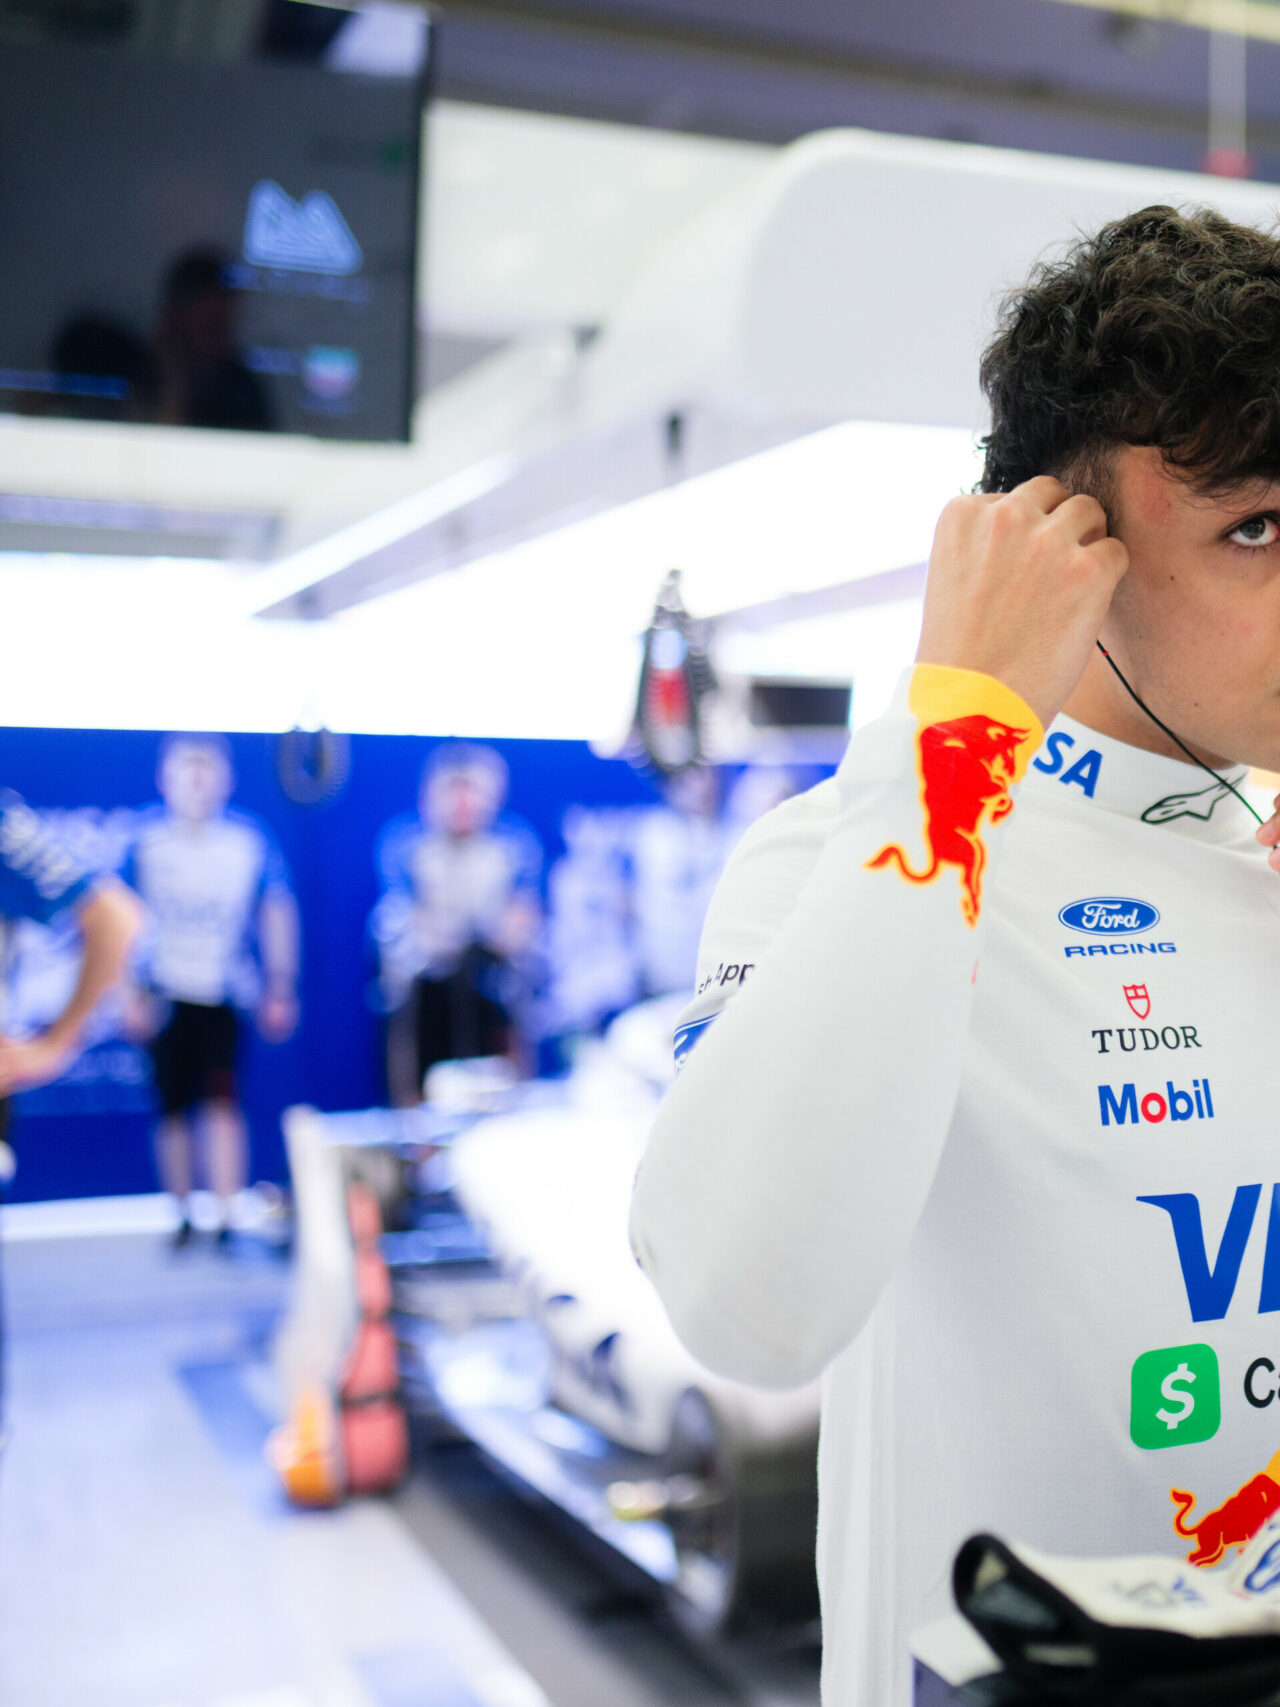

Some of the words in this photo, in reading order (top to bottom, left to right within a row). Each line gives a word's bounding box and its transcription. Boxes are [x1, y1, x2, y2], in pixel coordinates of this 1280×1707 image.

[1032, 732, 1103, 799] SA
[1082, 903, 1141, 929] Ford
[1064, 942, 1177, 958] RACING
[1092, 1026, 1202, 1053] TUDOR
[1098, 1078, 1214, 1126] Mobil
